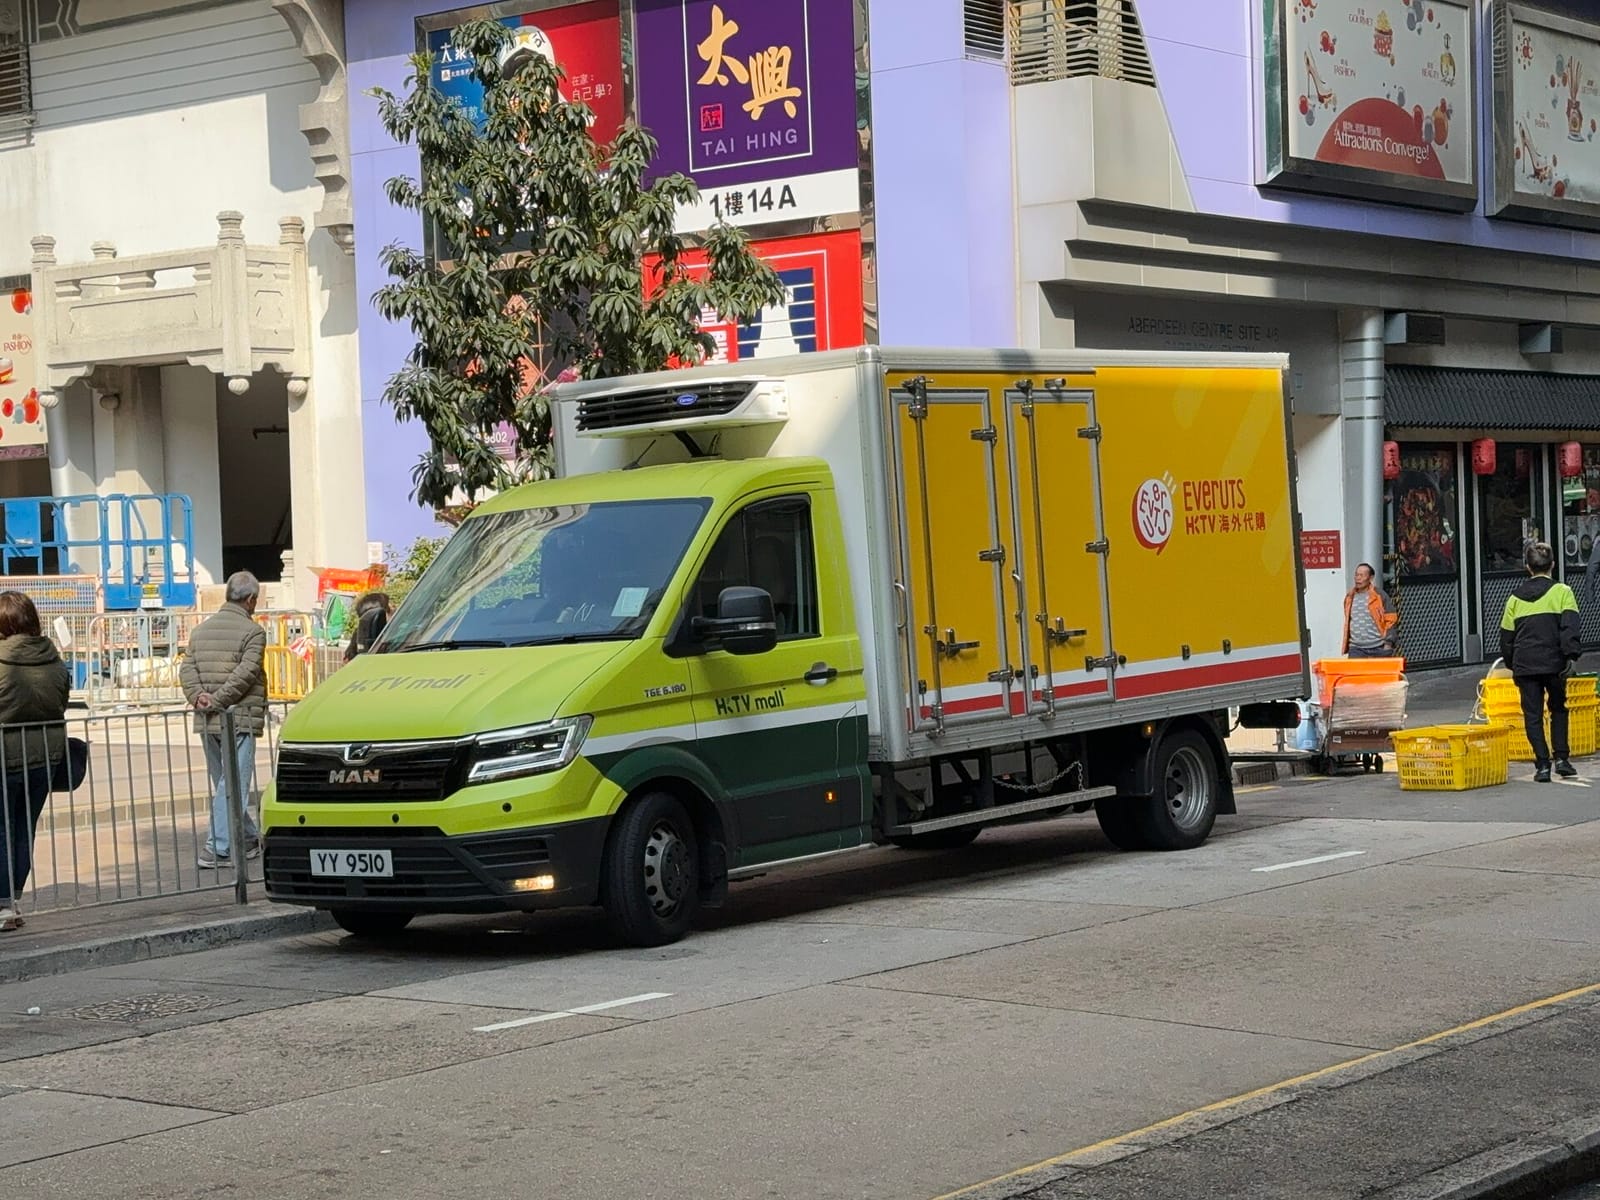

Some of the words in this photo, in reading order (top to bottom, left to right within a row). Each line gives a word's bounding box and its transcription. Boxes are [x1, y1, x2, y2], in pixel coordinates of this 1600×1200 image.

[697, 4, 801, 120] 太興
[702, 137, 735, 156] TAI
[746, 128, 798, 151] HING
[1334, 126, 1383, 153] Attractions
[1384, 137, 1430, 164] Converge!
[1128, 317, 1187, 336] ABERDEEN
[1191, 320, 1233, 340] CENTRE
[1238, 325, 1261, 341] SITE
[1185, 514, 1216, 535] HKTV
[1219, 511, 1266, 533] 海外代購
[644, 687, 662, 698] TGE
[715, 694, 750, 715] HKTV
[755, 689, 785, 711] mall
[329, 769, 381, 784] MAN
[317, 853, 338, 872] YY
[346, 853, 385, 873] 9510
